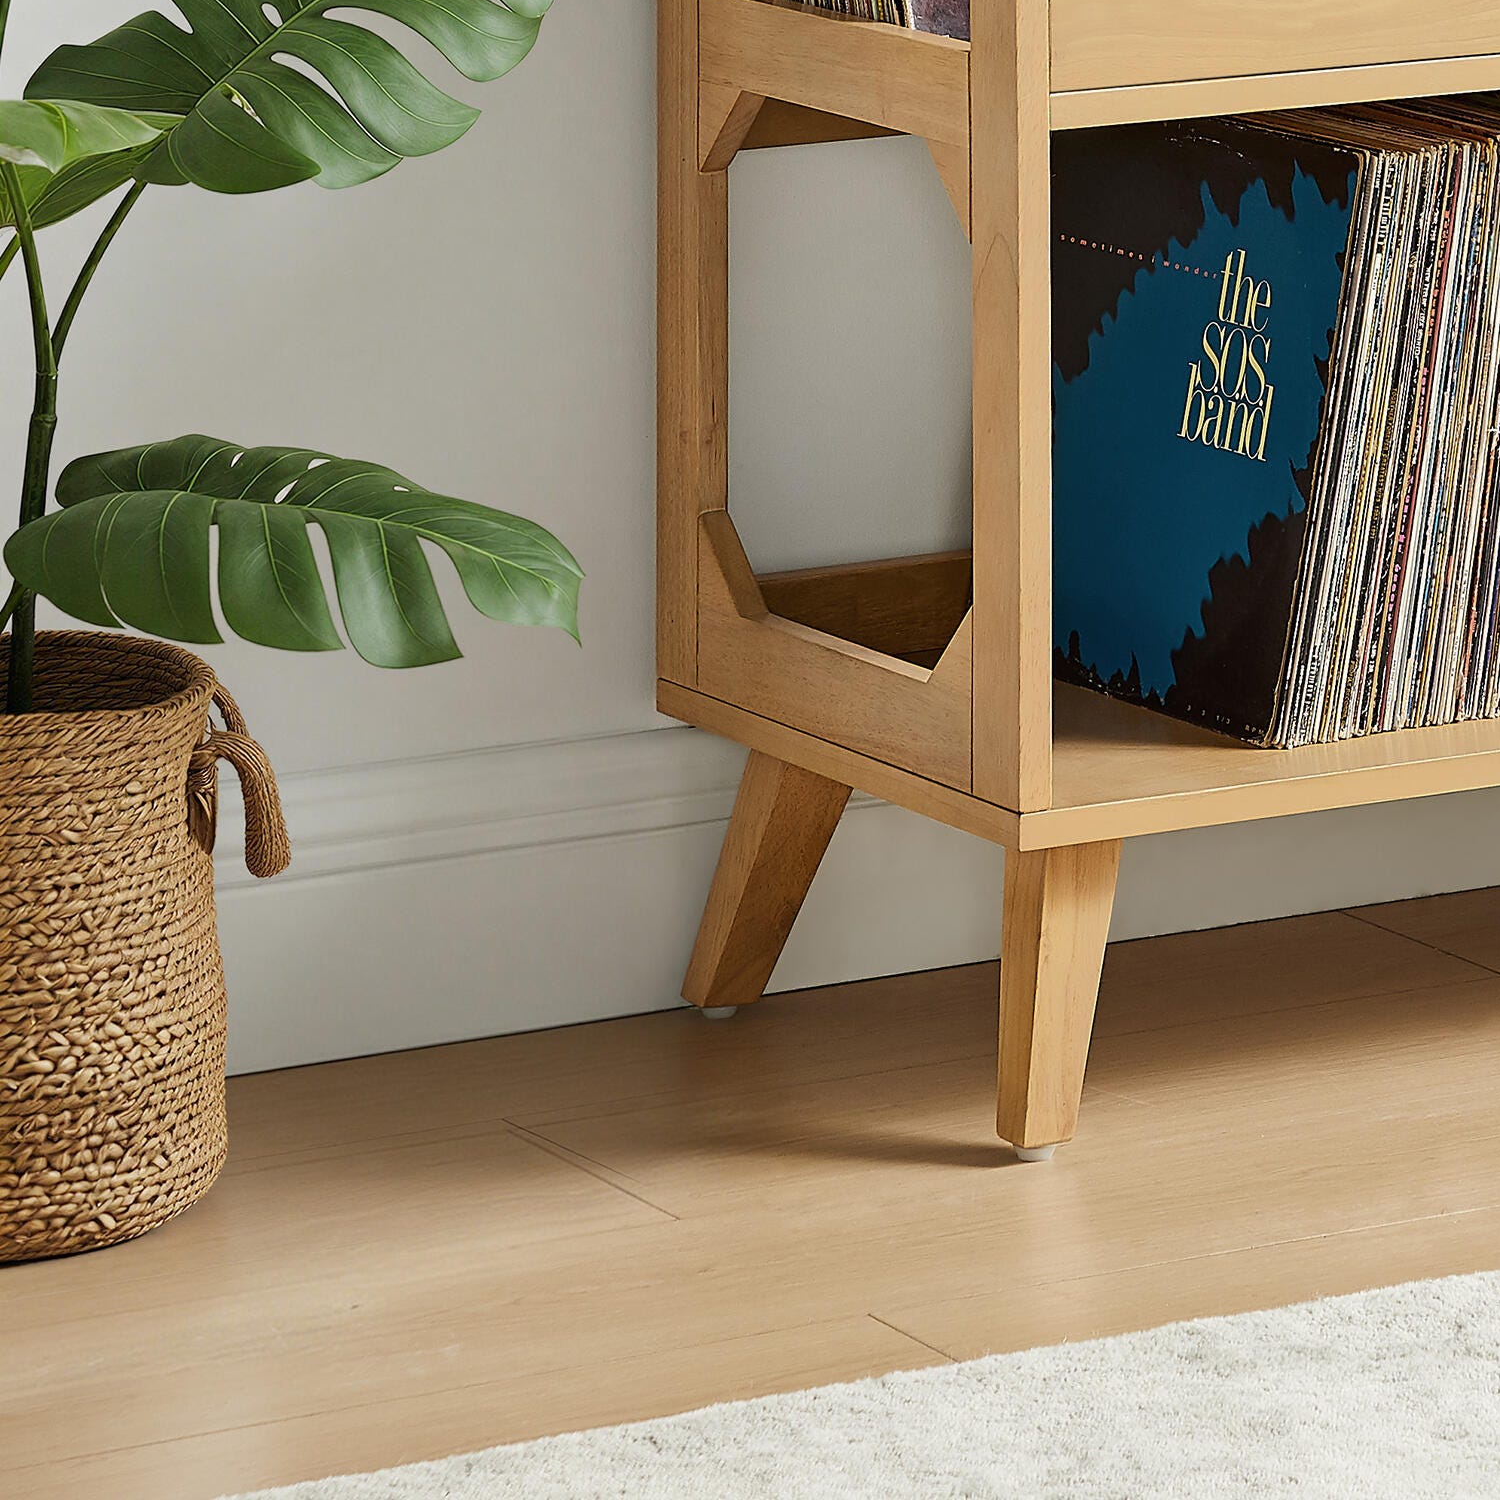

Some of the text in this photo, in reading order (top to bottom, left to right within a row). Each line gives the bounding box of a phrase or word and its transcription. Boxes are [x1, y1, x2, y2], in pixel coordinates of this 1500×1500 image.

[1060, 234, 1144, 261] sometimes
[1163, 260, 1217, 279] wonder
[1218, 248, 1272, 333] the
[1176, 362, 1274, 462] band
